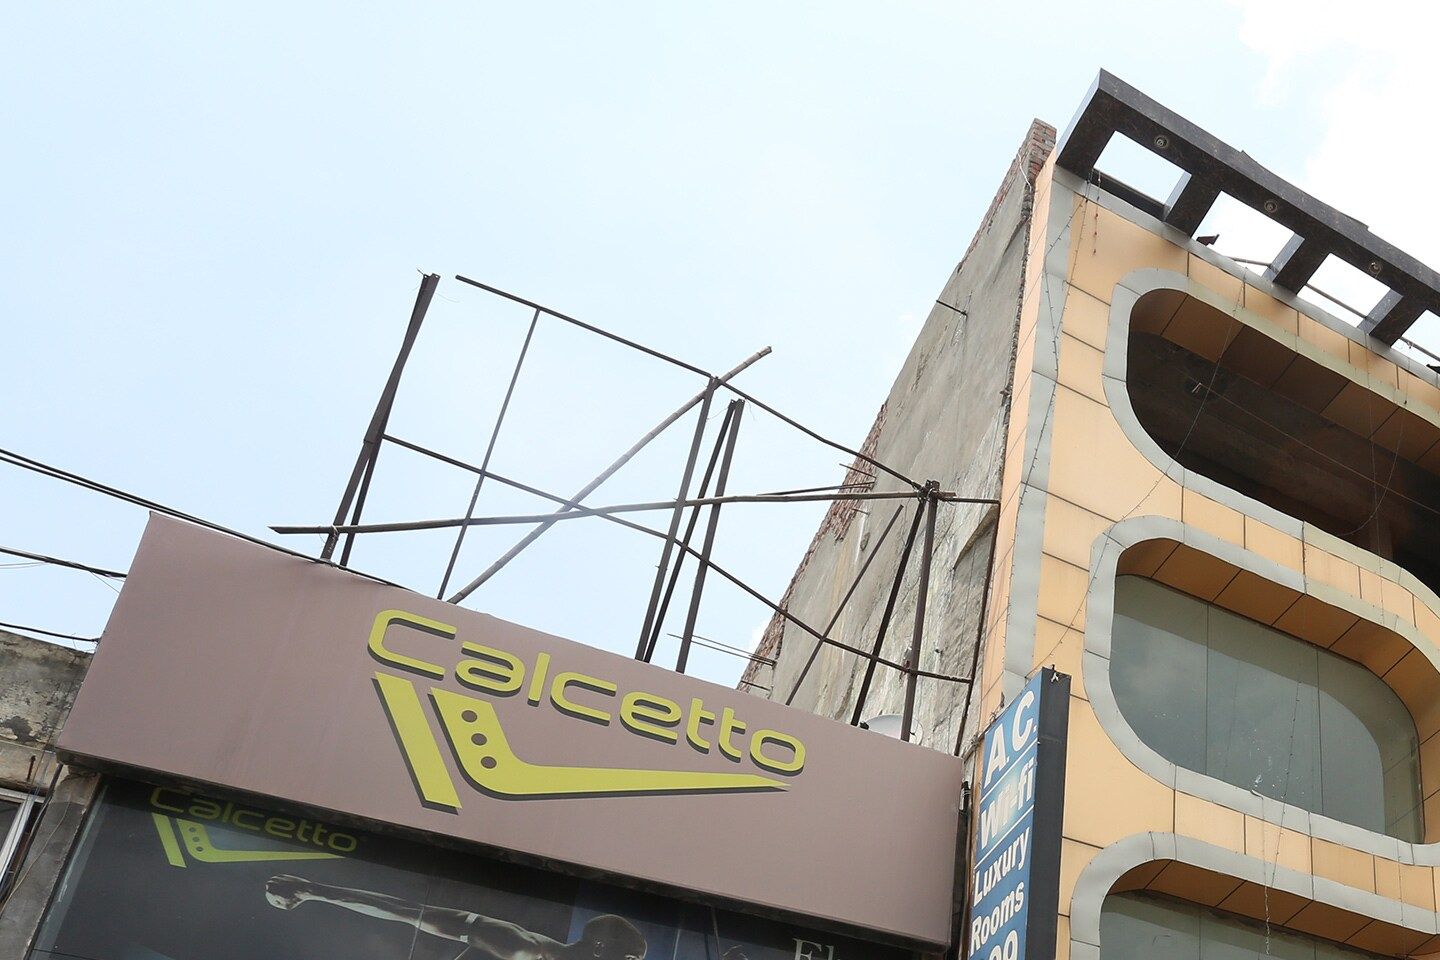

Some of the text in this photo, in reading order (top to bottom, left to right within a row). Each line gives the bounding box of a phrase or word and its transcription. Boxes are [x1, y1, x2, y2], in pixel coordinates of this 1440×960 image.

[367, 609, 807, 776] Calcetto
[151, 786, 358, 852] Calcetto
[974, 827, 1031, 908] Luxury
[970, 881, 1024, 957] Rooms
